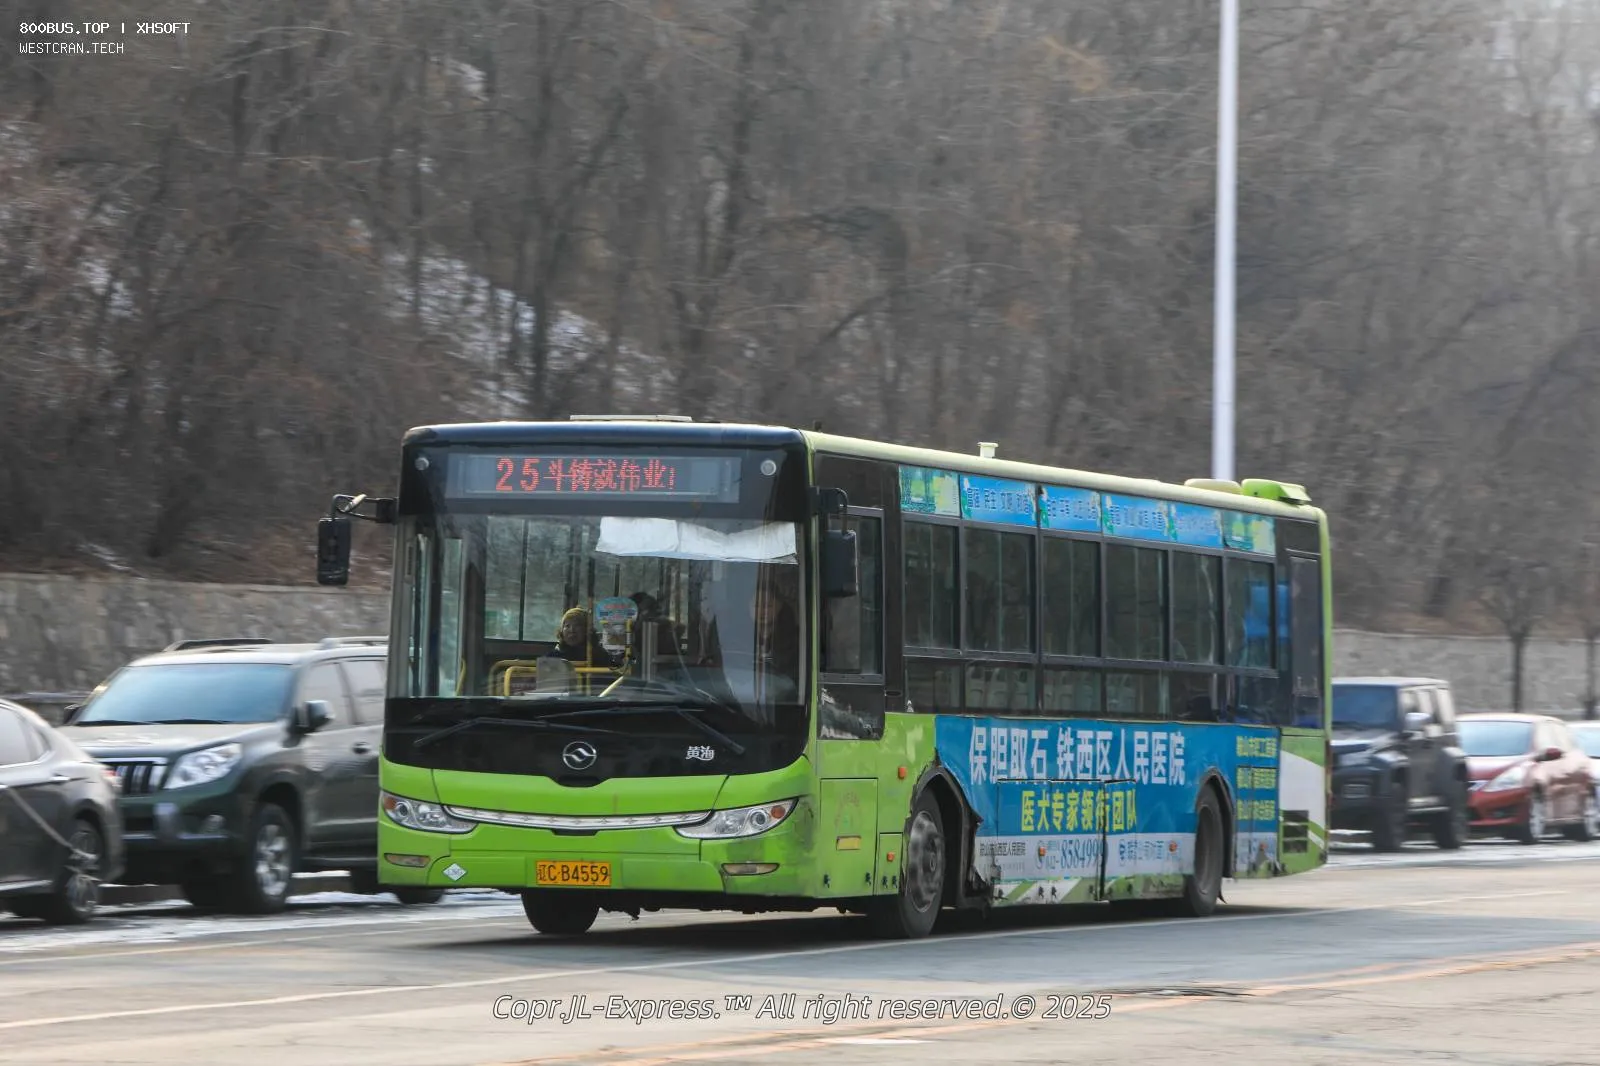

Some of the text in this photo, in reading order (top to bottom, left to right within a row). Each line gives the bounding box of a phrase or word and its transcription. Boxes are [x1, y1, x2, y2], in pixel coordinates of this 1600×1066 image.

[495, 457, 541, 492] 25
[969, 725, 1186, 786] 保胆取石 铁西区人民医院
